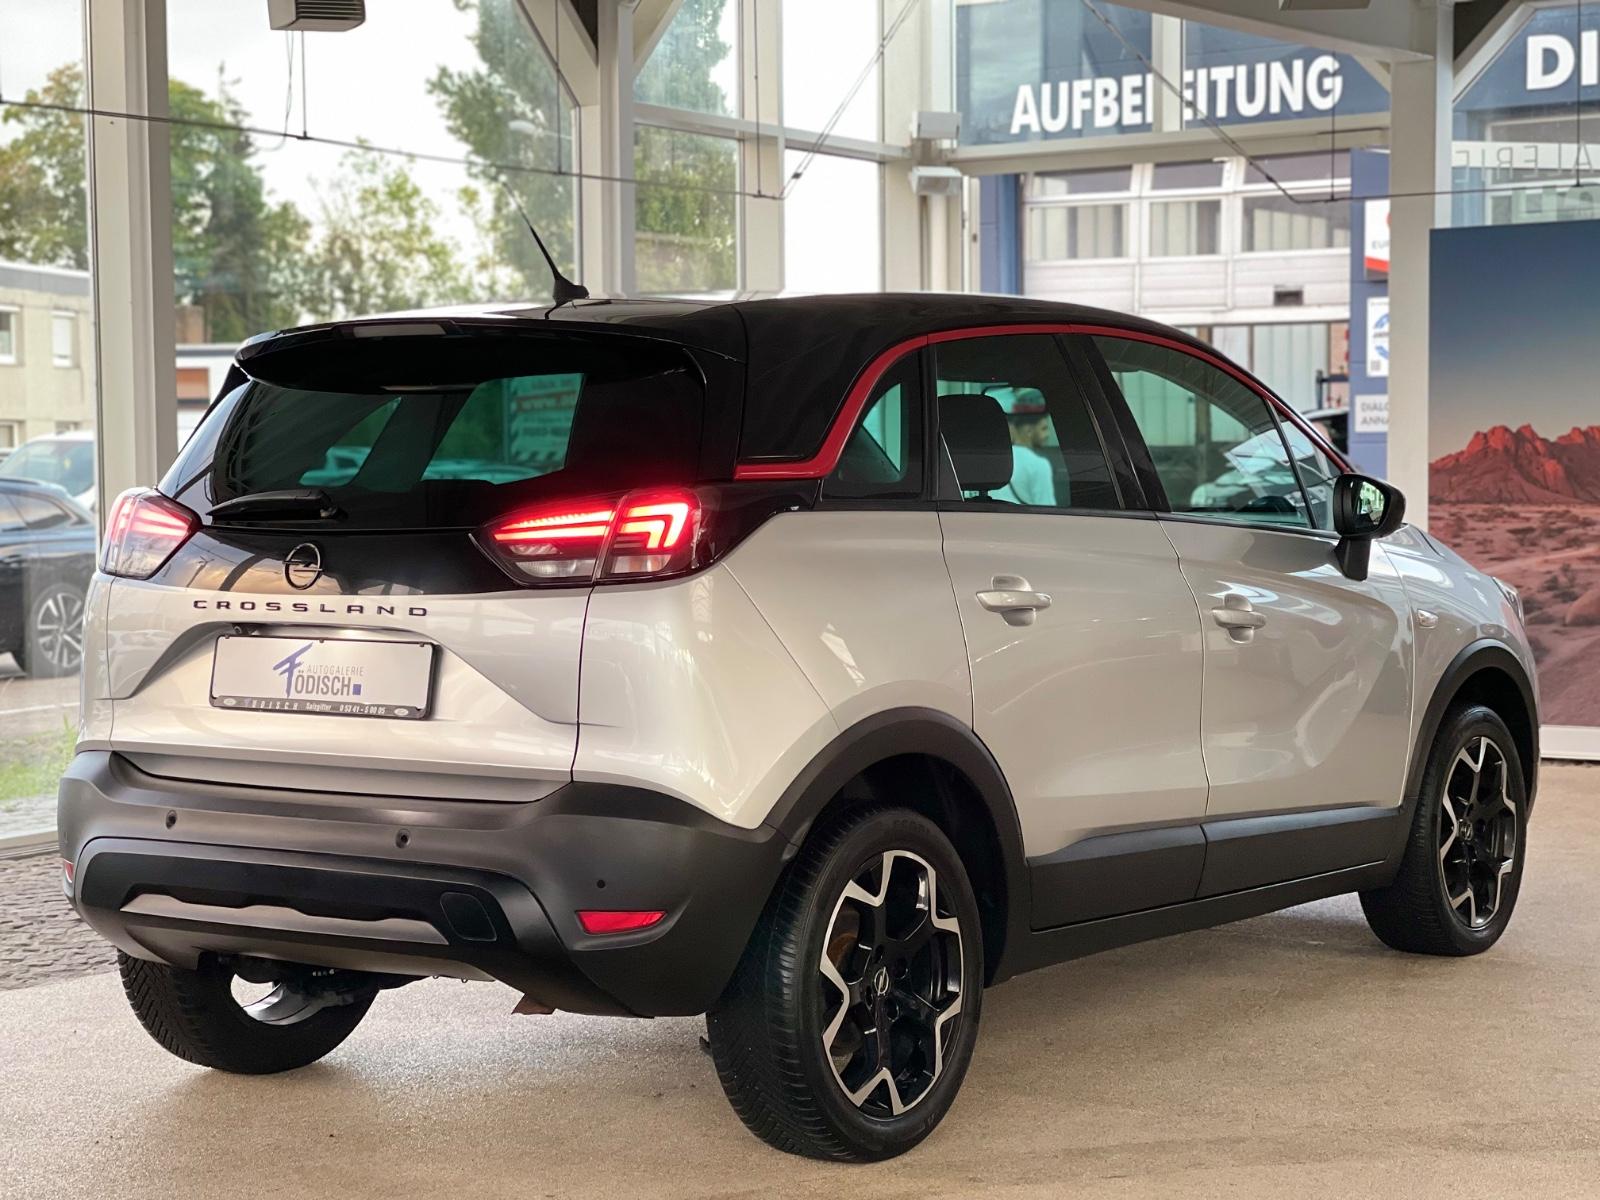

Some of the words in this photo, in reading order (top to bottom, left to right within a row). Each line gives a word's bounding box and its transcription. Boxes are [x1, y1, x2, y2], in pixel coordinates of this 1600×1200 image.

[1526, 30, 1598, 90] DI
[193, 600, 427, 617] CROSSLAND
[307, 664, 365, 677] AUTOGALERIE
